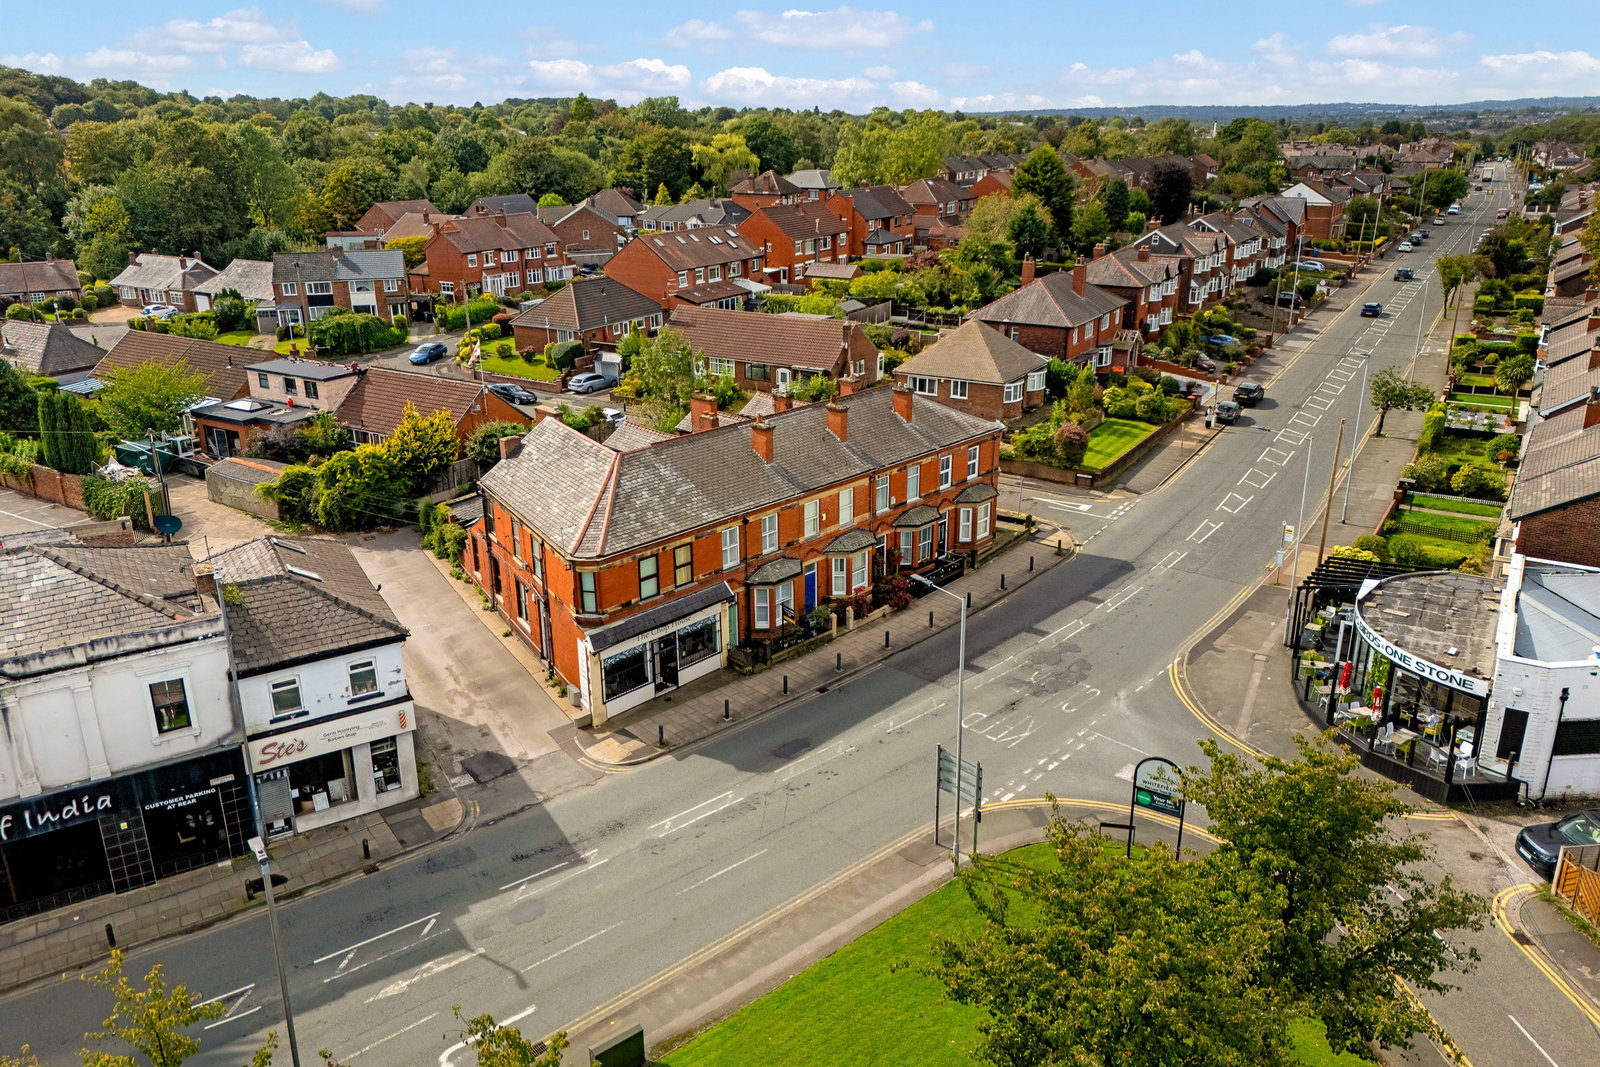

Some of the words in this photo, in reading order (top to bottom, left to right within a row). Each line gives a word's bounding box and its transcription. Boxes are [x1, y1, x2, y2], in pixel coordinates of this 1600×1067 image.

[637, 631, 650, 641] The
[651, 624, 670, 636] Chop
[1359, 623, 1381, 648] BIRDS
[1385, 645, 1412, 667] ONE
[1415, 660, 1475, 690] STONE
[345, 731, 357, 739] Shop
[259, 738, 308, 765] Ste's
[1142, 779, 1177, 793] WHITEFIELD
[144, 796, 184, 811] CUSTOMER
[184, 787, 217, 800] PARKING
[167, 803, 176, 811] AT
[177, 798, 197, 808] REAR
[1153, 795, 1166, 803] Your
[0, 813, 12, 840] f
[25, 793, 112, 830] India
